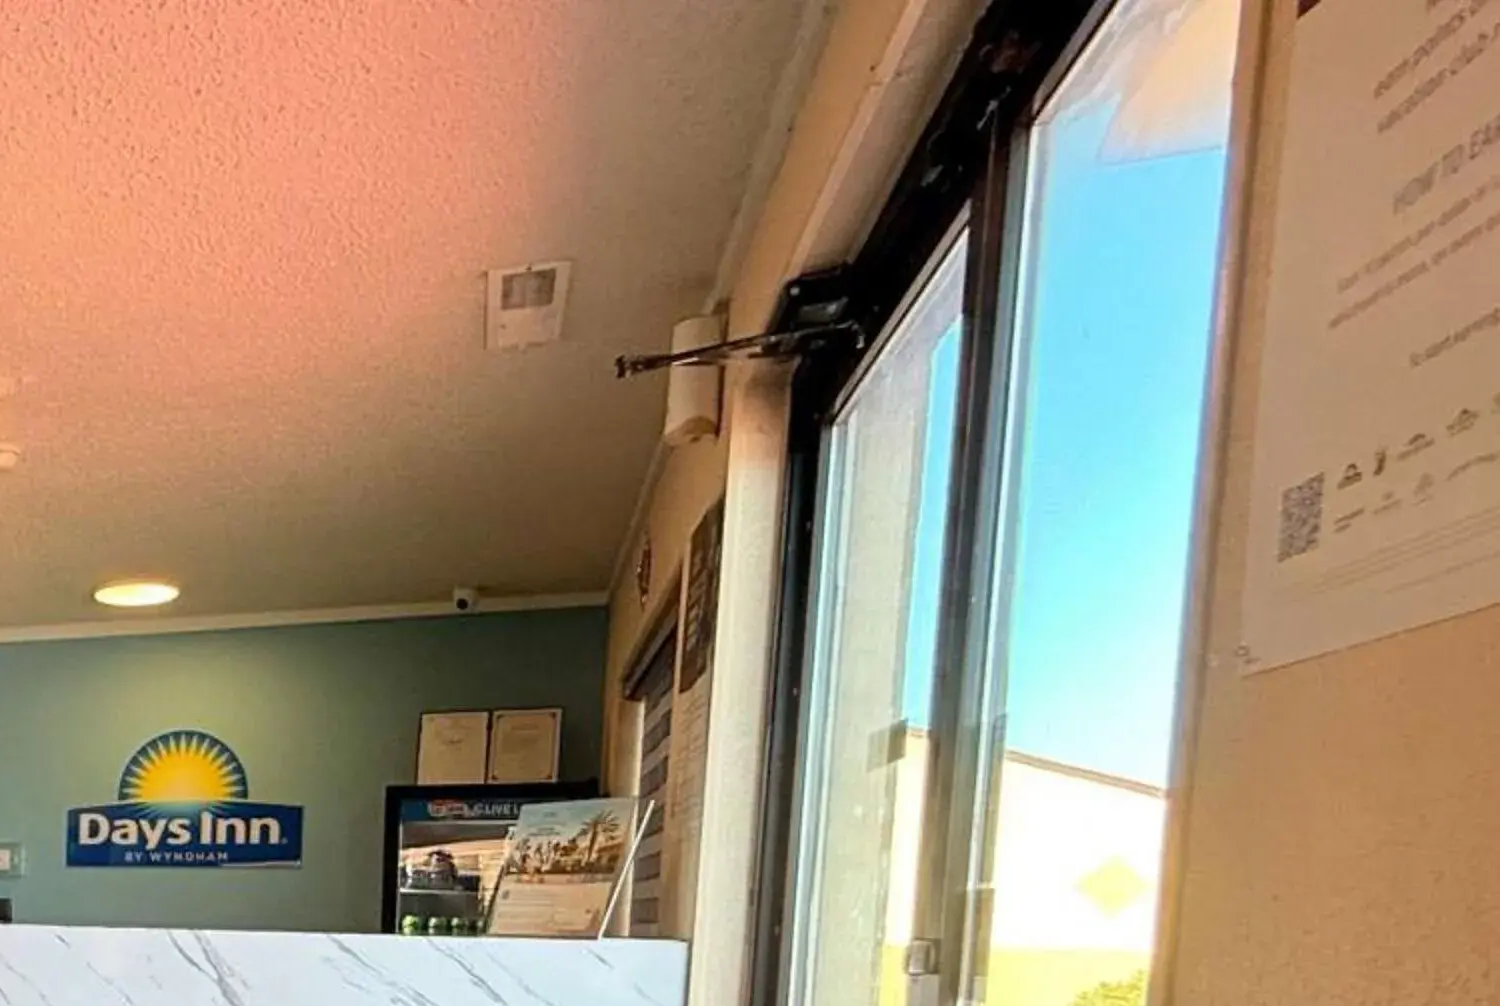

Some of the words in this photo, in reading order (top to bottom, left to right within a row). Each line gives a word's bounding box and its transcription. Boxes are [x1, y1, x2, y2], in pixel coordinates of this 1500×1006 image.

[78, 812, 191, 849] Days
[200, 811, 281, 844] Inn
[124, 852, 141, 862] BY
[150, 852, 228, 862] WYNDHAM
